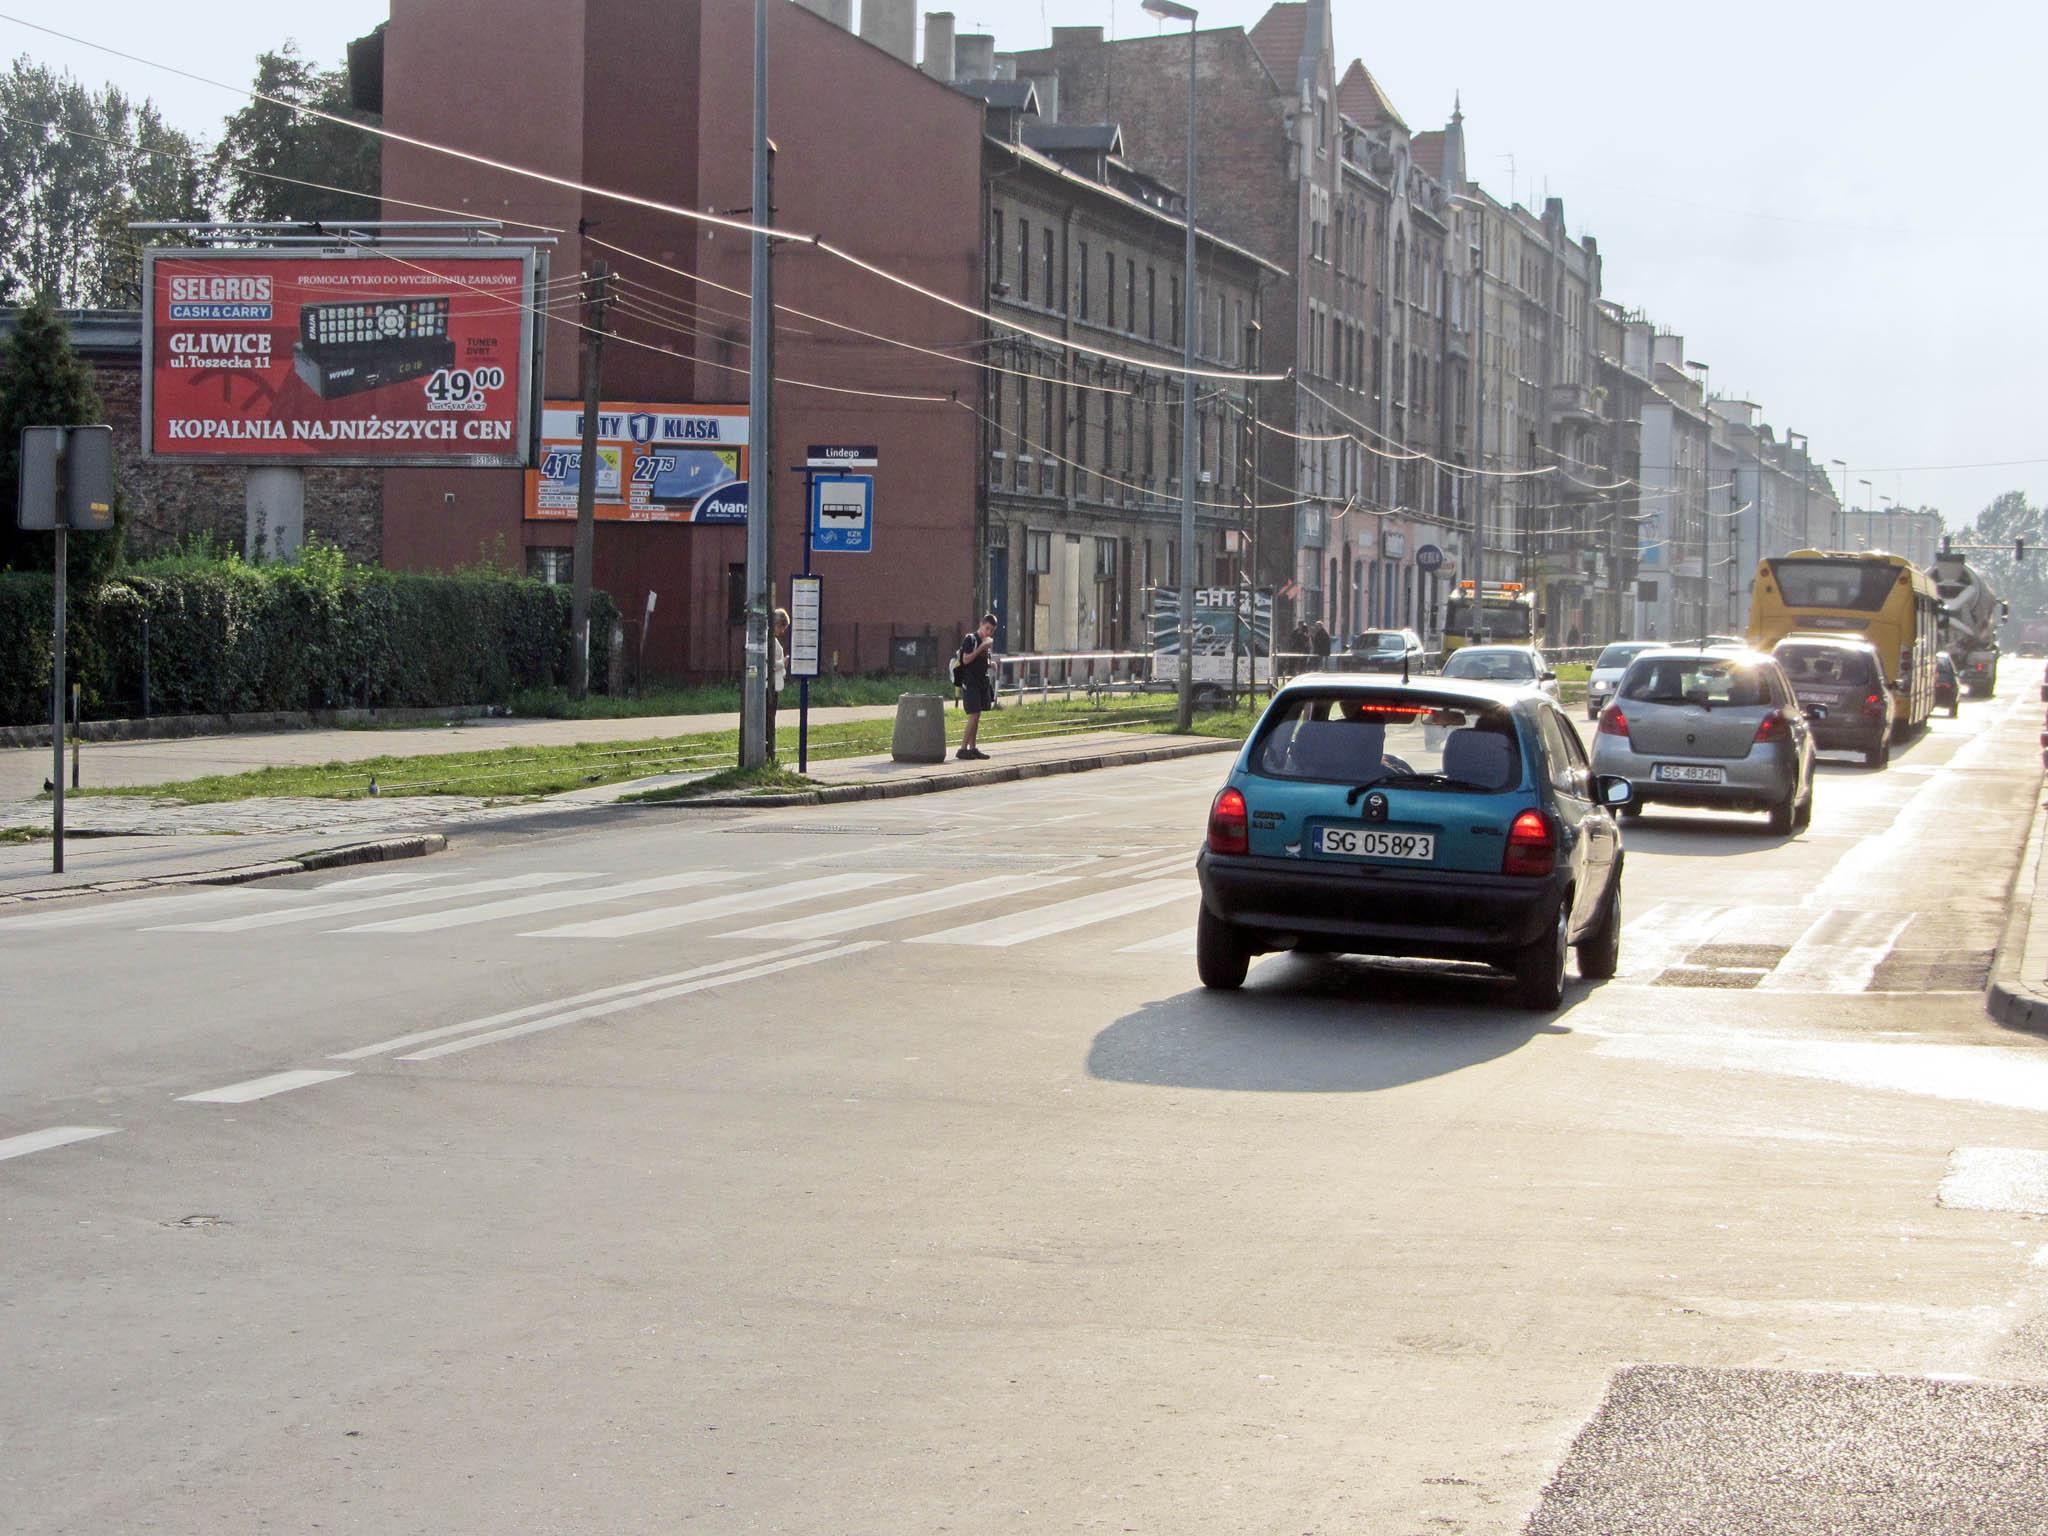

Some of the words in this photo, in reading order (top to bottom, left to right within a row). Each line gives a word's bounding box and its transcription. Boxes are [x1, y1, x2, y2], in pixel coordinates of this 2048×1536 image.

[298, 275, 349, 285] PROMOCJA
[351, 275, 381, 285] TYLKO
[383, 275, 398, 285] DO
[400, 275, 466, 285] WYCZERPANIA
[468, 273, 517, 285] ZAPASÓW!
[172, 278, 271, 300] SELGROS
[173, 306, 210, 318] CASH
[212, 307, 220, 317] &
[222, 307, 268, 318] CARRY
[170, 333, 272, 354] GLIWICE
[170, 355, 251, 369] ul.Toszecka
[254, 356, 271, 369] 11
[168, 419, 288, 439] KOPALNIA
[291, 415, 457, 441] NAJNIŻSZYCH
[463, 419, 512, 440] CEN
[632, 416, 649, 440] 1
[663, 418, 720, 440] KLASA
[825, 448, 860, 459] Lindego
[1663, 766, 1680, 778] SG
[1684, 768, 1719, 780] 4834H
[1326, 831, 1357, 852] SG
[1364, 833, 1431, 857] 05893
